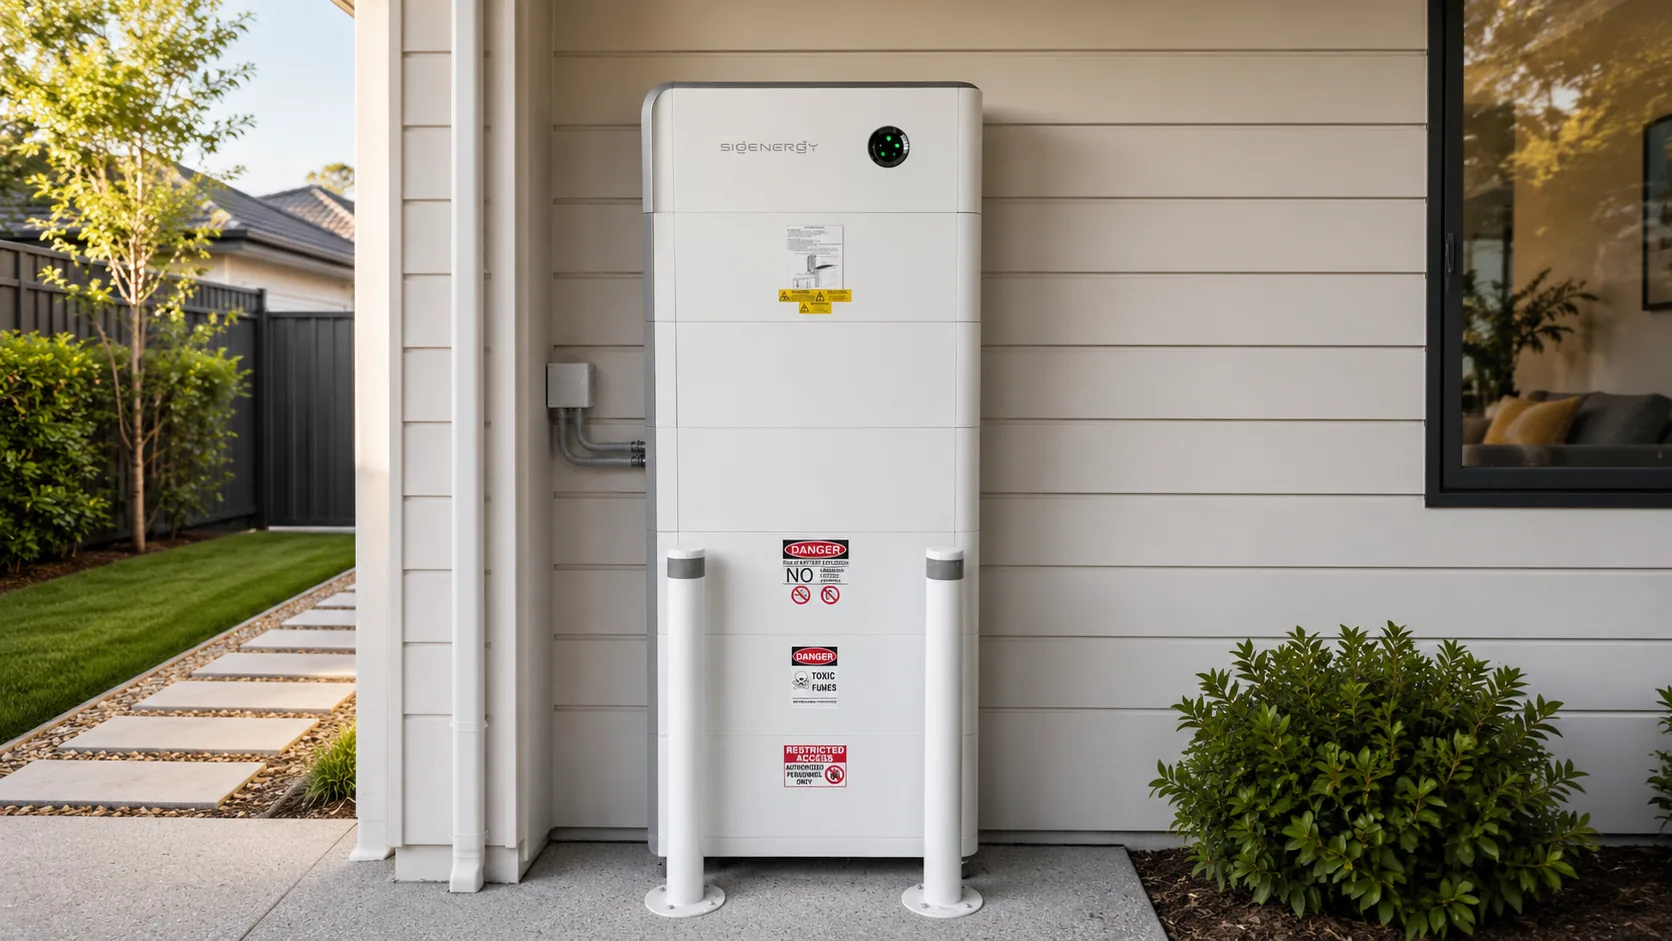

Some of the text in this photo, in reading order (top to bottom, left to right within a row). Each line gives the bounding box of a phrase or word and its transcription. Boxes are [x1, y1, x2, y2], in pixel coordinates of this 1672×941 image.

[720, 141, 819, 154] SIGENERGY
[791, 545, 840, 555] DANGER
[786, 567, 814, 583] NO
[796, 652, 833, 661] DANGER
[811, 671, 836, 680] TOXIC
[786, 746, 845, 754] RESTRICTED
